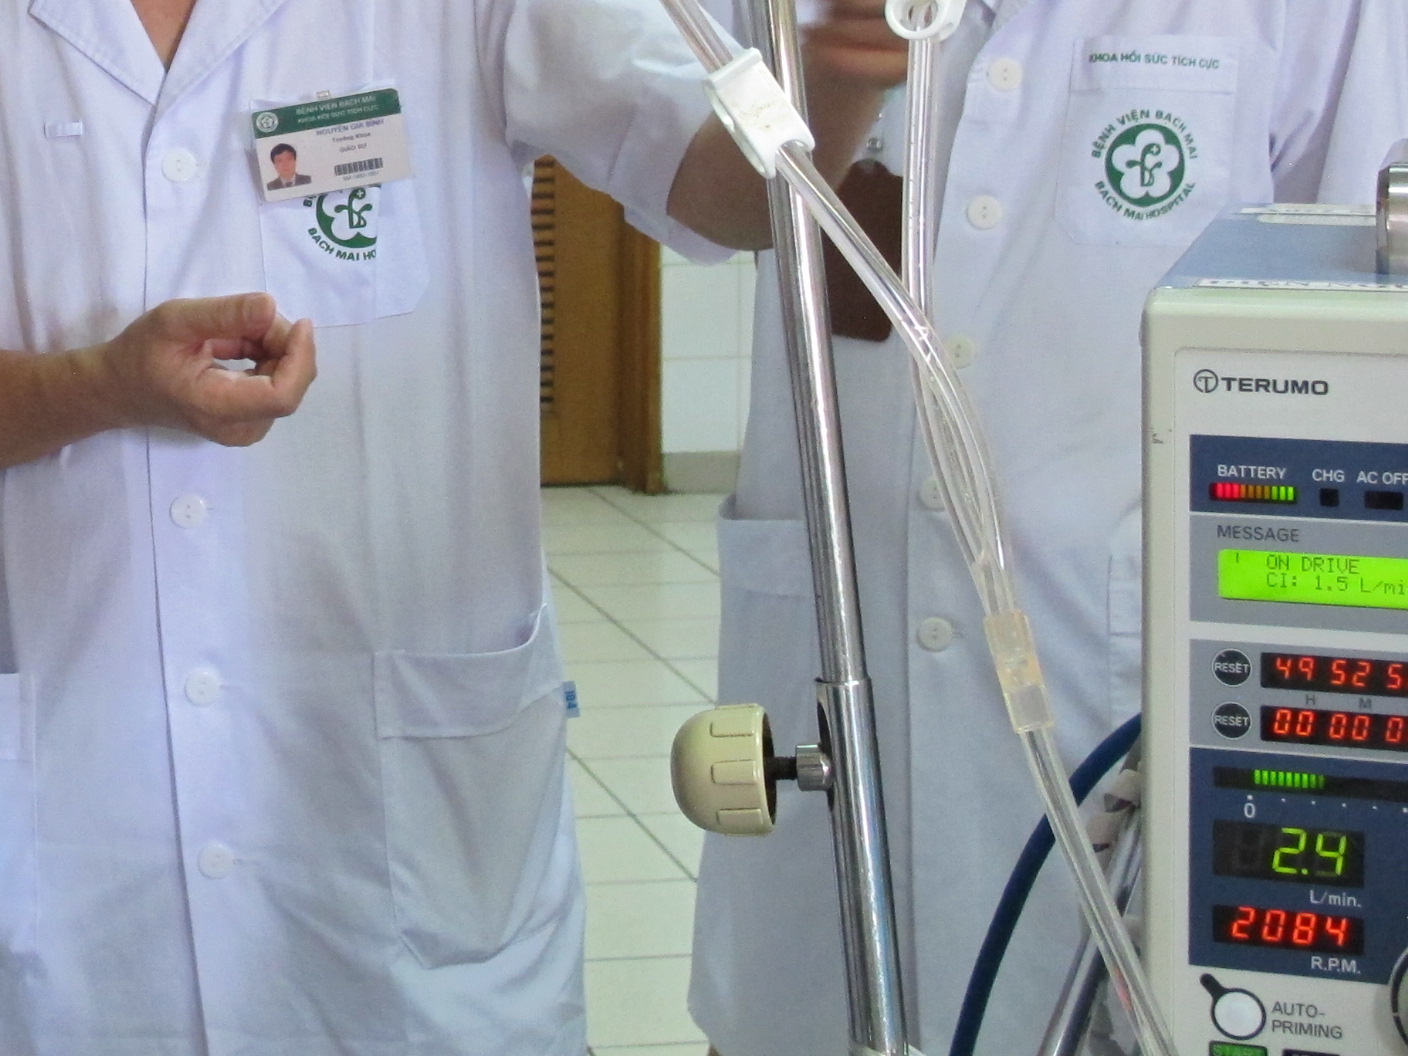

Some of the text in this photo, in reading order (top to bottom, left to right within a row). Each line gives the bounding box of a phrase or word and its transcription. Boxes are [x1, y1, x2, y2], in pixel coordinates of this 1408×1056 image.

[1088, 52, 1118, 63] KHOA
[1120, 50, 1141, 63] HỒI
[1144, 53, 1168, 65] SỨC
[1171, 55, 1196, 67] TÍCH
[1091, 123, 1117, 158] BỆNH
[1116, 109, 1150, 126] VIỆN
[1183, 132, 1198, 160] MAI
[1094, 180, 1197, 221] BACH MAI HOSPITAL
[307, 227, 335, 255] BACH
[335, 249, 360, 261] MAI
[1221, 377, 1329, 396] TERUMO
[1217, 464, 1287, 480] BATTERY
[1312, 468, 1345, 483] CHG
[1356, 470, 1378, 484] AC
[1217, 524, 1300, 542] MESSAGE
[1266, 554, 1360, 574] ON DRIVE
[1266, 572, 1298, 588] CI:
[1315, 576, 1349, 592] 1.5
[1214, 661, 1251, 675] RESET
[1275, 656, 1316, 682] 49
[1330, 659, 1371, 688] 52
[1305, 694, 1316, 705] H
[1358, 697, 1373, 709] M
[1214, 714, 1250, 727] RESET
[1273, 709, 1315, 736] 00
[1328, 713, 1370, 741] 00
[1243, 802, 1256, 819] 0
[1272, 826, 1347, 876] 2.4
[1309, 890, 1363, 908] L/min.
[1230, 906, 1349, 947] 2084
[1310, 956, 1362, 975] R.P.M.
[1271, 1001, 1325, 1018] AUTO-
[1271, 1019, 1343, 1040] PRIMING
